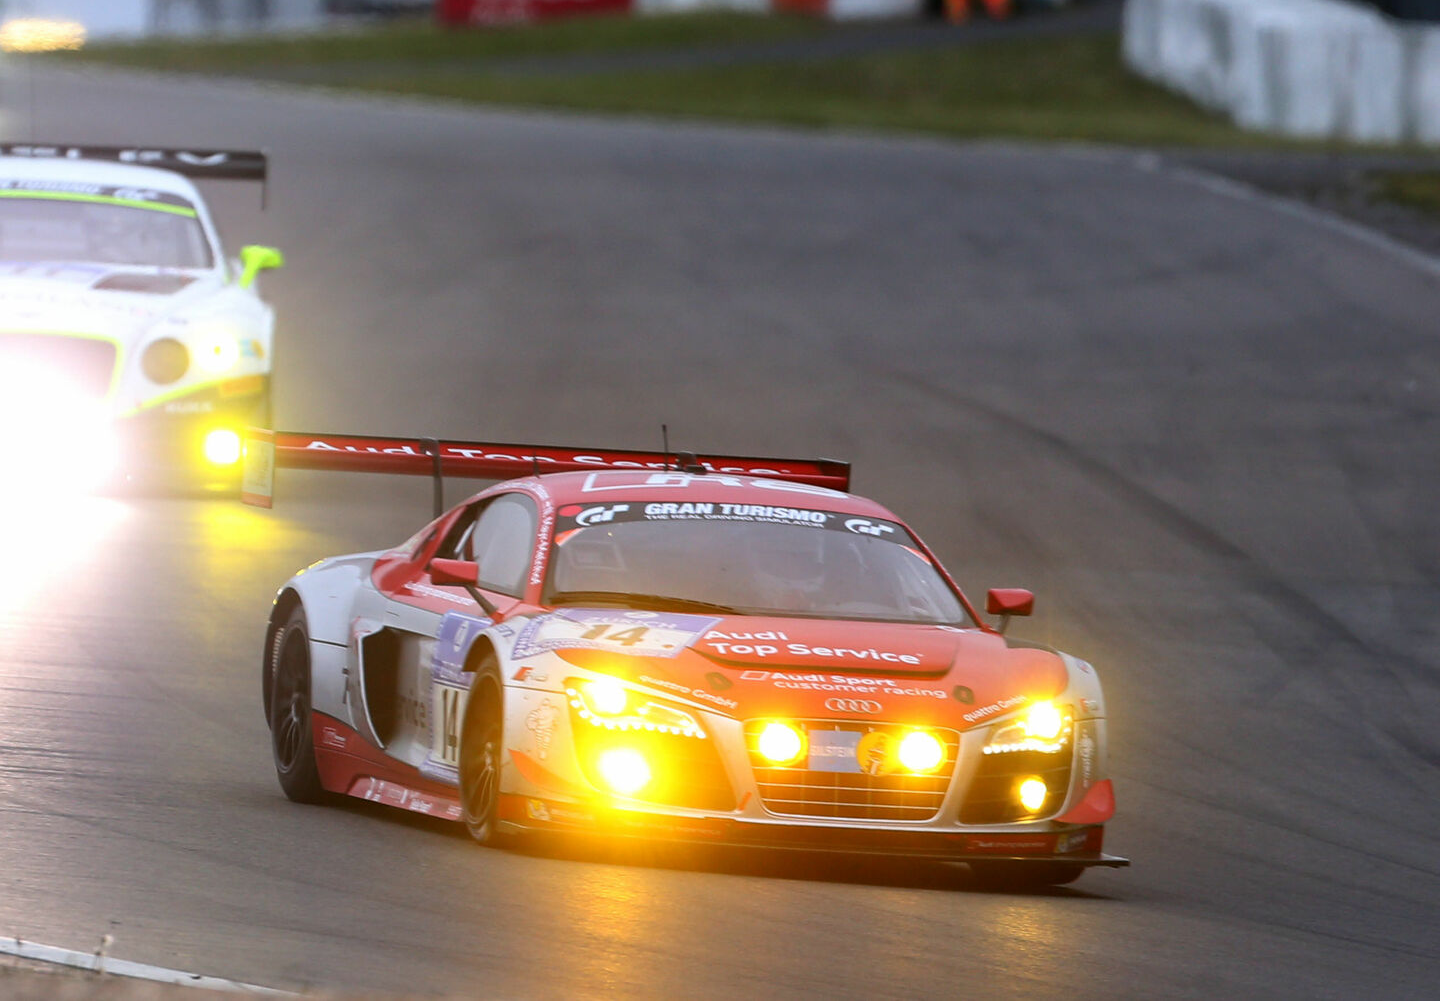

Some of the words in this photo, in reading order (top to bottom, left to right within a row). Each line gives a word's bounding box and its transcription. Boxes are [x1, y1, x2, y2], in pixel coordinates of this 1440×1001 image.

[644, 502, 714, 516] GRAN
[719, 503, 828, 524] TURISMO
[703, 514, 755, 523] DRIVING
[755, 517, 825, 529] SIMULATOR
[580, 624, 651, 647] 14
[703, 629, 789, 642] Audi
[707, 641, 779, 657] Top
[788, 642, 922, 666] Service
[770, 671, 826, 684] Audi
[829, 674, 897, 687] Sport
[772, 680, 877, 695] customer
[881, 685, 948, 699] racing
[639, 674, 691, 694] quattro
[691, 687, 738, 710] GmbH
[962, 701, 1000, 723] quattro
[441, 688, 461, 762] 14
